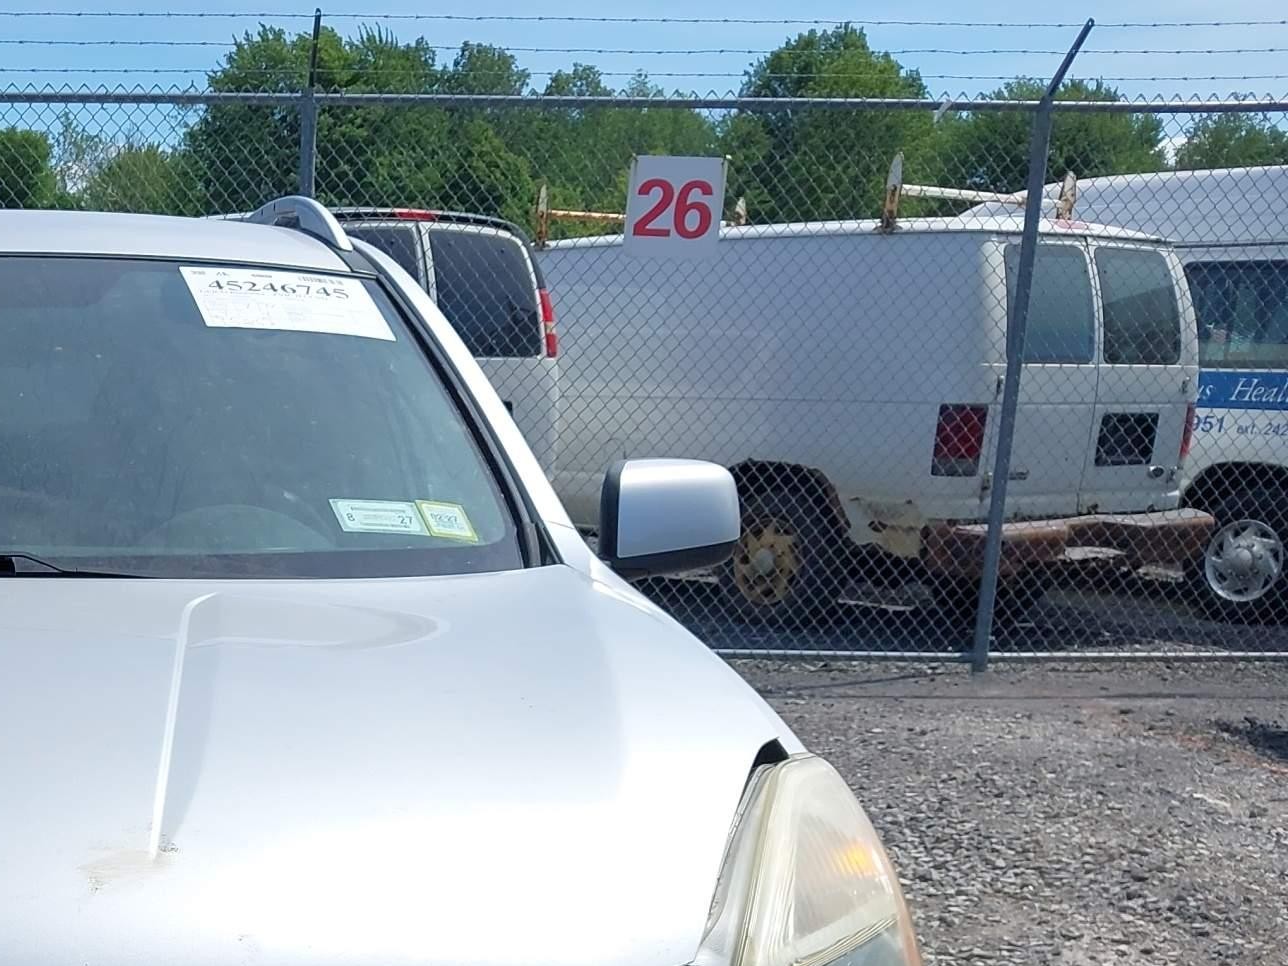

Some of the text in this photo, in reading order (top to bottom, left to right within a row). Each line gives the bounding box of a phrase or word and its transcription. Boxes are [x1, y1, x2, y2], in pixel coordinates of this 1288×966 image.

[632, 178, 714, 239] 26
[208, 279, 350, 300] 45246745
[1230, 377, 1288, 402] Heal
[397, 514, 413, 525] 27
